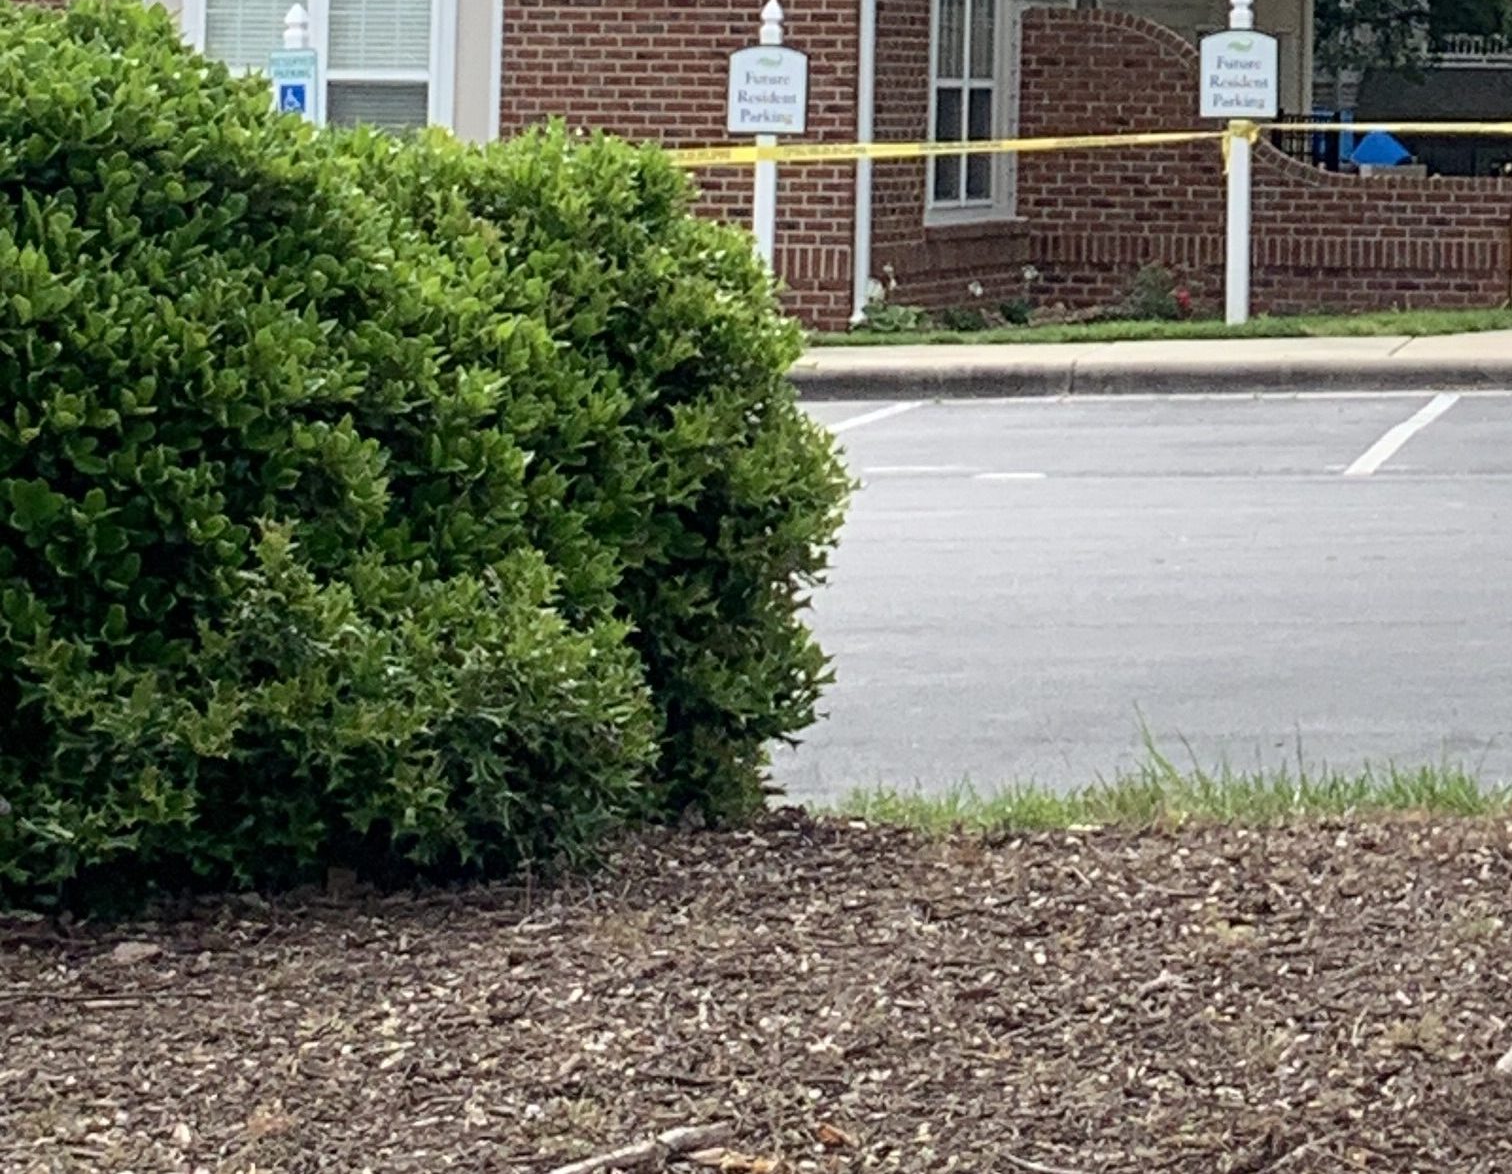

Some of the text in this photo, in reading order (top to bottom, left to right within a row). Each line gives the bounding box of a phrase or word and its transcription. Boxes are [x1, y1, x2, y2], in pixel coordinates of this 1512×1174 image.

[1216, 56, 1262, 70] Future
[745, 71, 791, 85] Future
[1209, 74, 1269, 88] Resident
[737, 90, 797, 104] Resident
[1212, 93, 1265, 109] Parking
[740, 109, 793, 125] Parking
